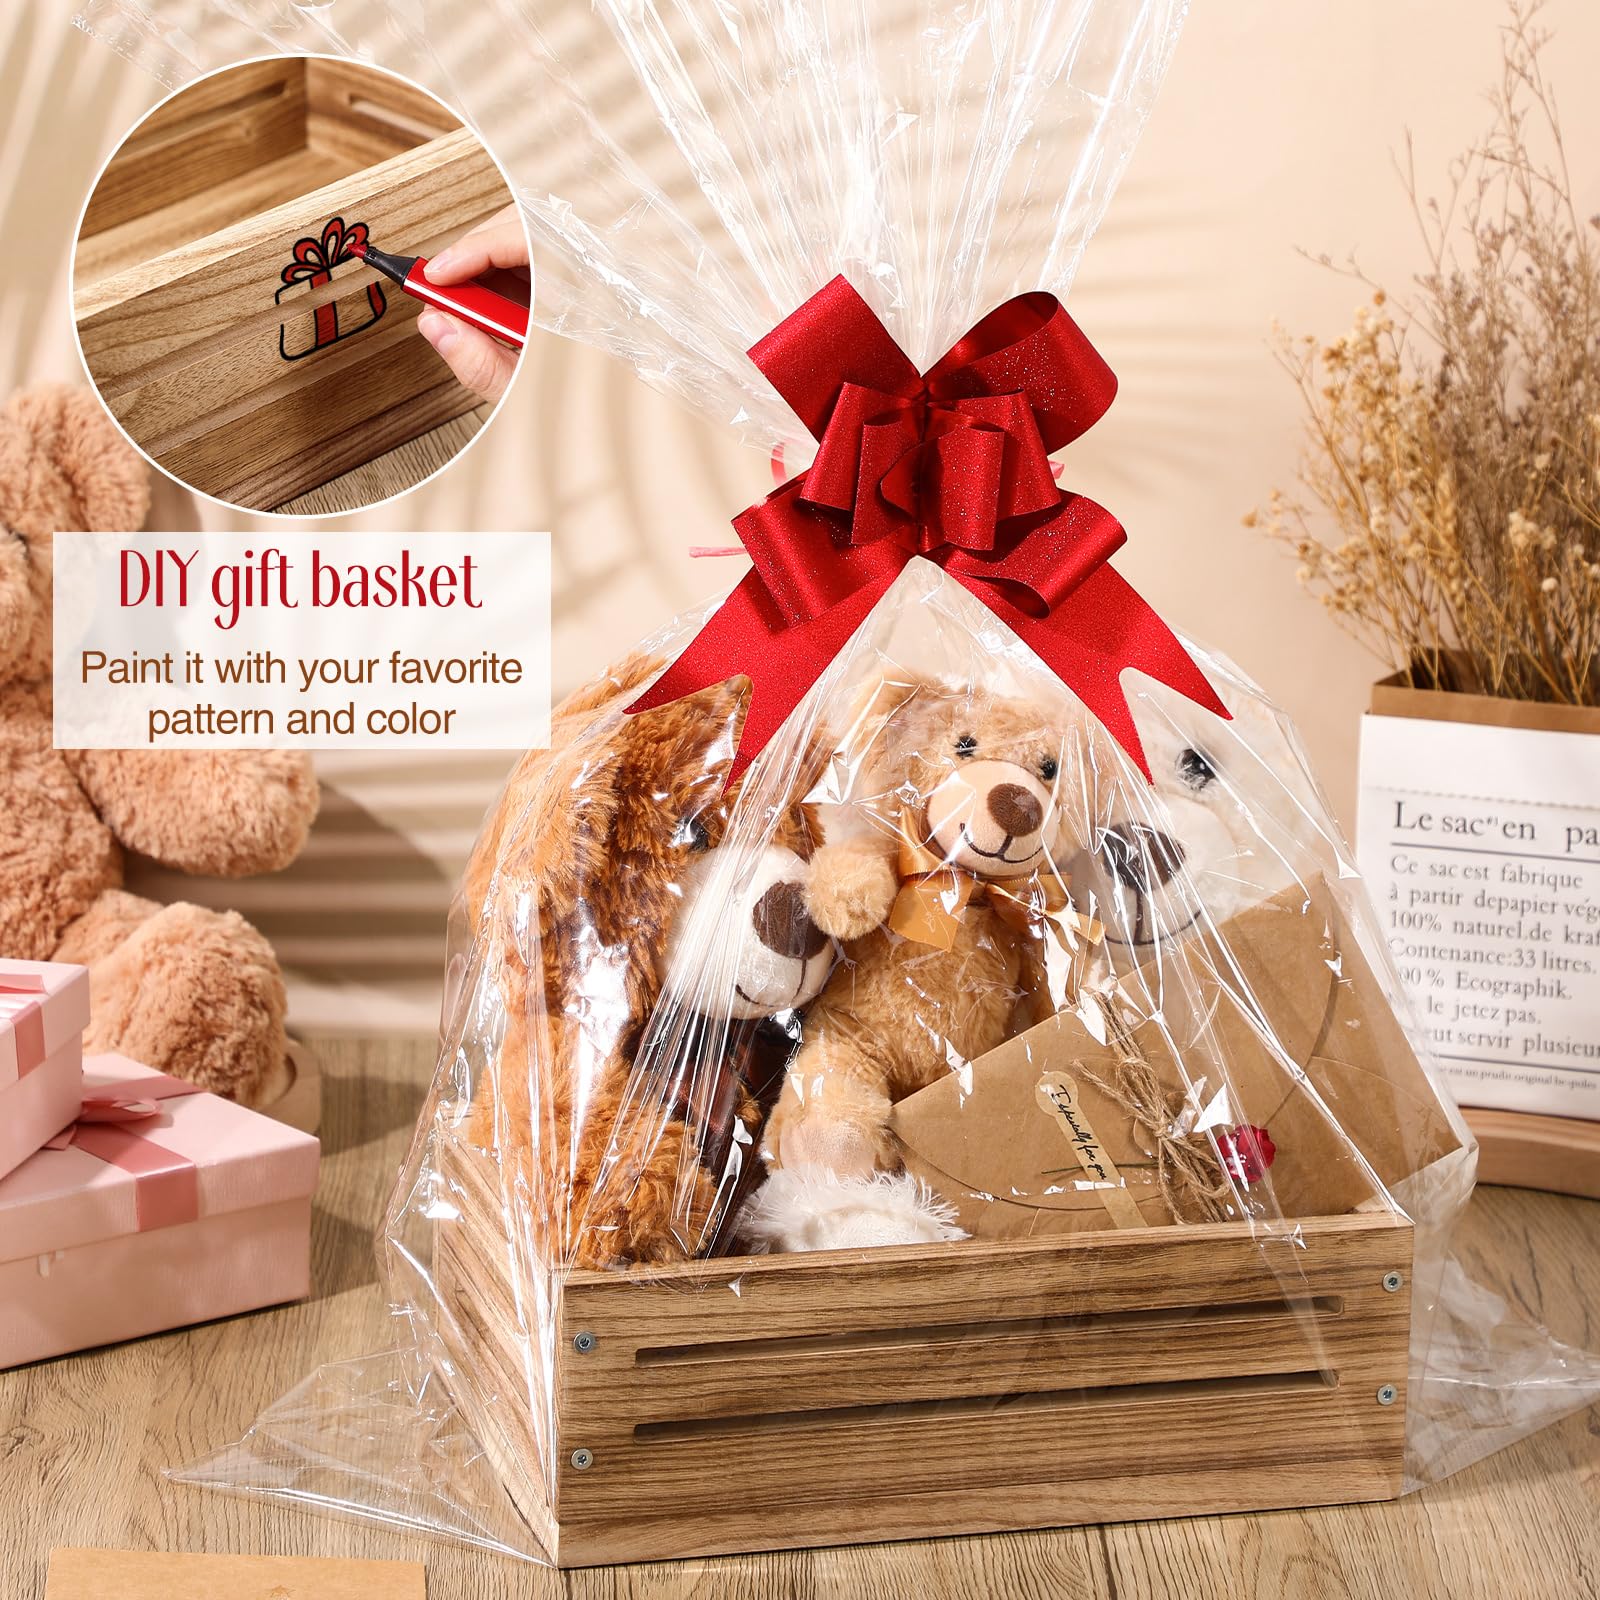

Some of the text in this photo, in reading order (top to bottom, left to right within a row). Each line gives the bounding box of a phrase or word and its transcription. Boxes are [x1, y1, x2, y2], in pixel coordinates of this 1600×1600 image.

[1394, 800, 1432, 832] Le
[1502, 820, 1536, 840] en
[1391, 854, 1418, 874] Ce
[1409, 887, 1464, 907] partir
[1391, 909, 1442, 932] 100%
[1542, 951, 1597, 974] litres.
[1451, 997, 1499, 1022] jetez
[1457, 1029, 1512, 1049] servir
[1077, 1144, 1099, 1162] for
